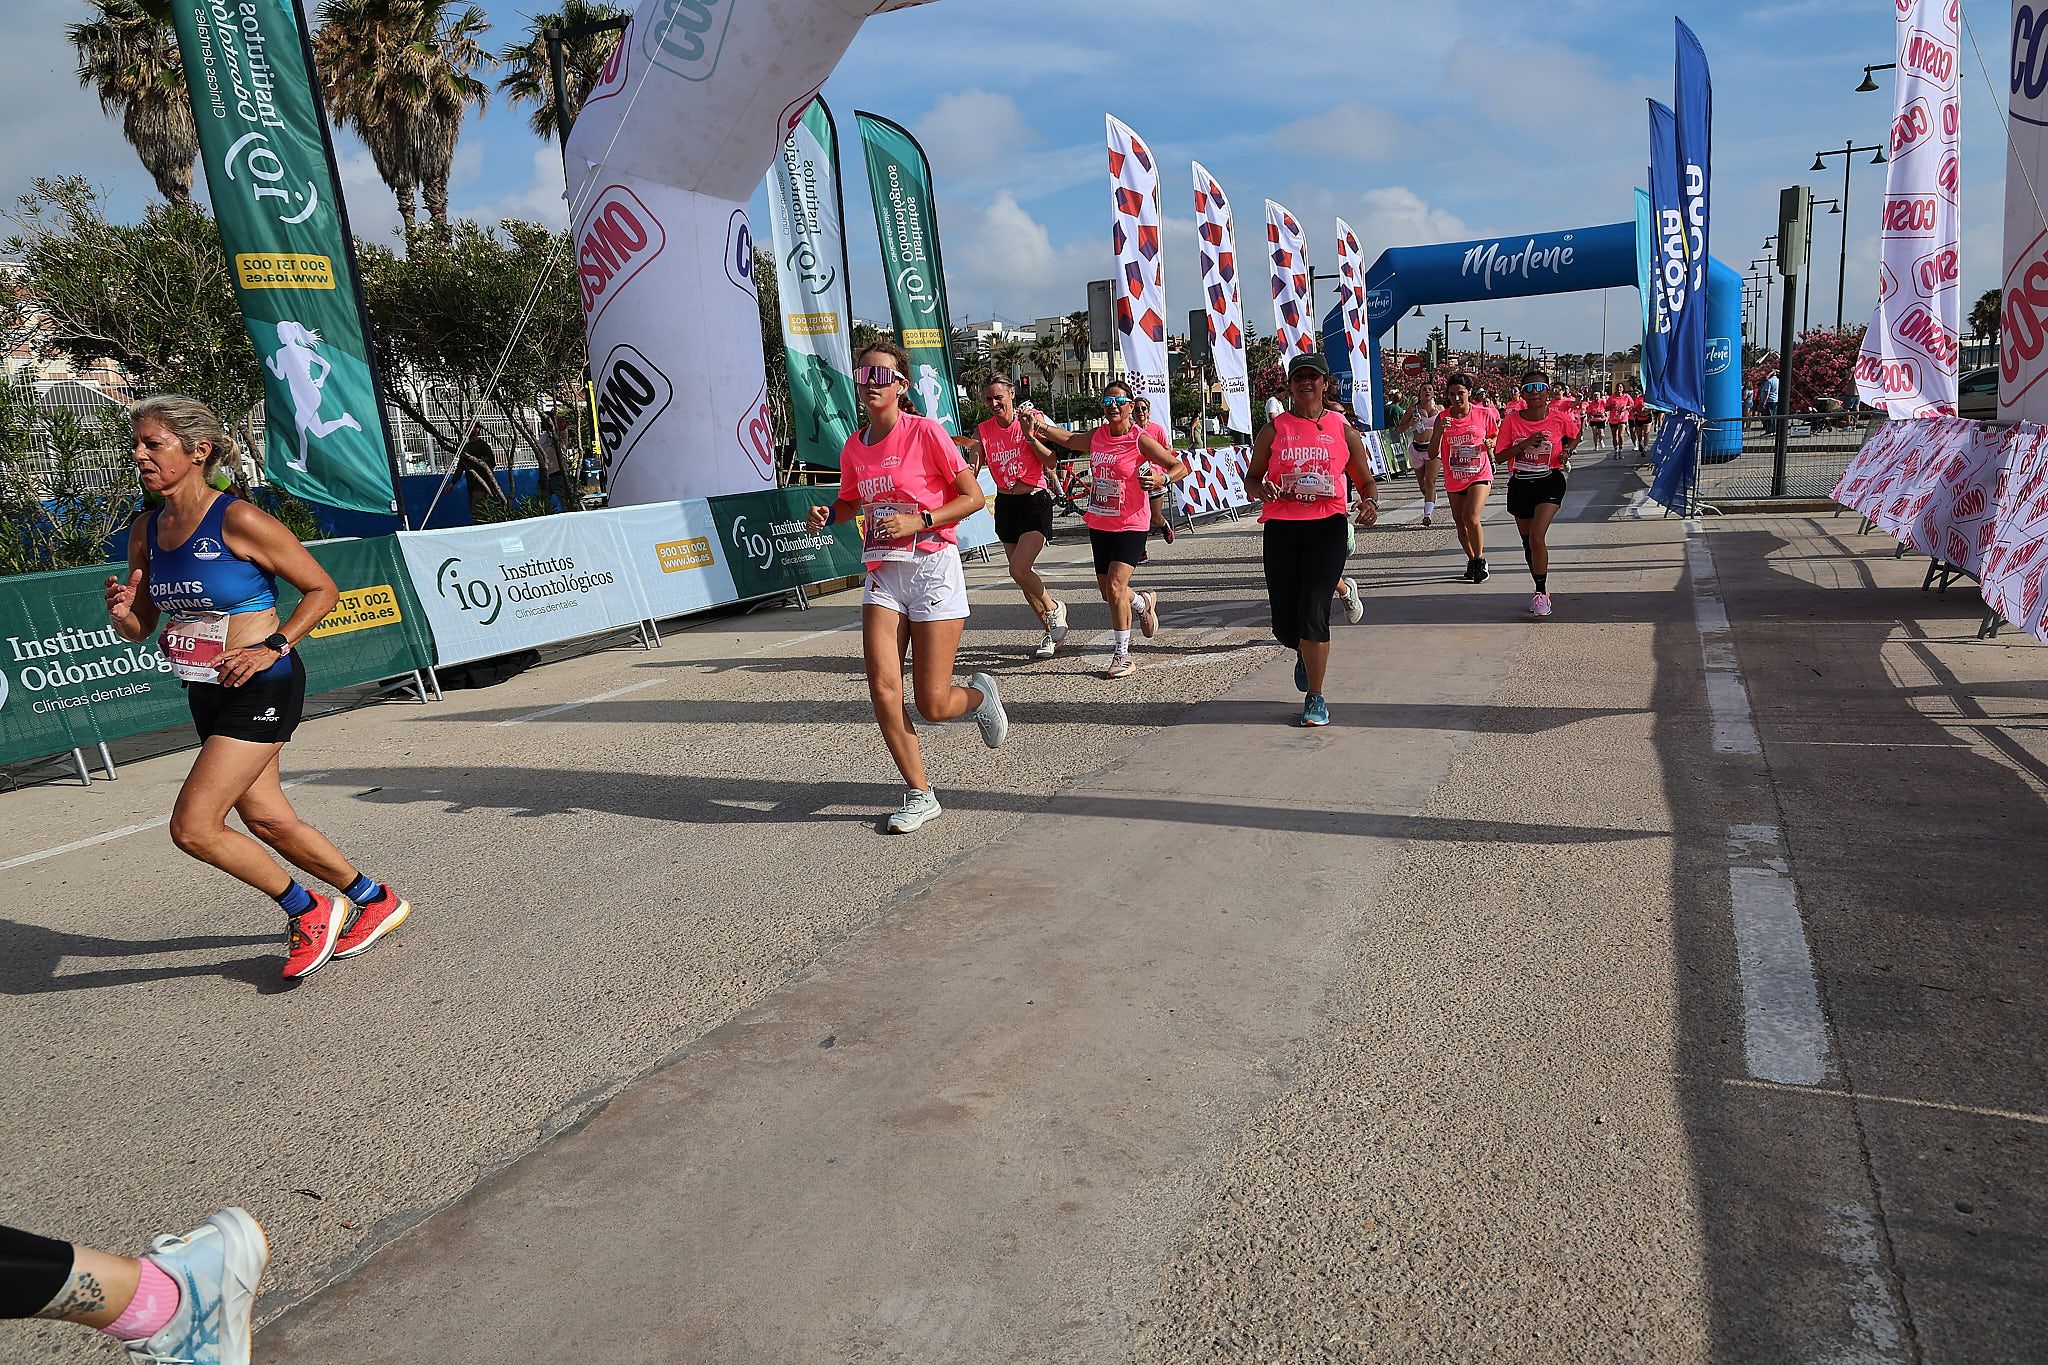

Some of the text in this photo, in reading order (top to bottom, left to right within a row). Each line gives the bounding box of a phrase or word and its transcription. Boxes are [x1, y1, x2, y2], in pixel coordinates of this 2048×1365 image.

[653, 0, 719, 61] CO
[1461, 238, 1574, 291] Marlene
[1705, 346, 1729, 362] rlene
[1281, 446, 1329, 461] CARRERA
[857, 474, 896, 498] RRERA
[768, 519, 807, 536] Instituto
[660, 546, 677, 558] 900
[691, 541, 707, 552] 002
[498, 556, 575, 582] Institutos
[507, 570, 614, 602] Odontológicos
[339, 596, 360, 611] 131
[363, 591, 391, 606] 002
[315, 606, 395, 630] www.ioa.es
[6, 624, 134, 662] Institut
[32, 681, 151, 714] Clínicas dentales
